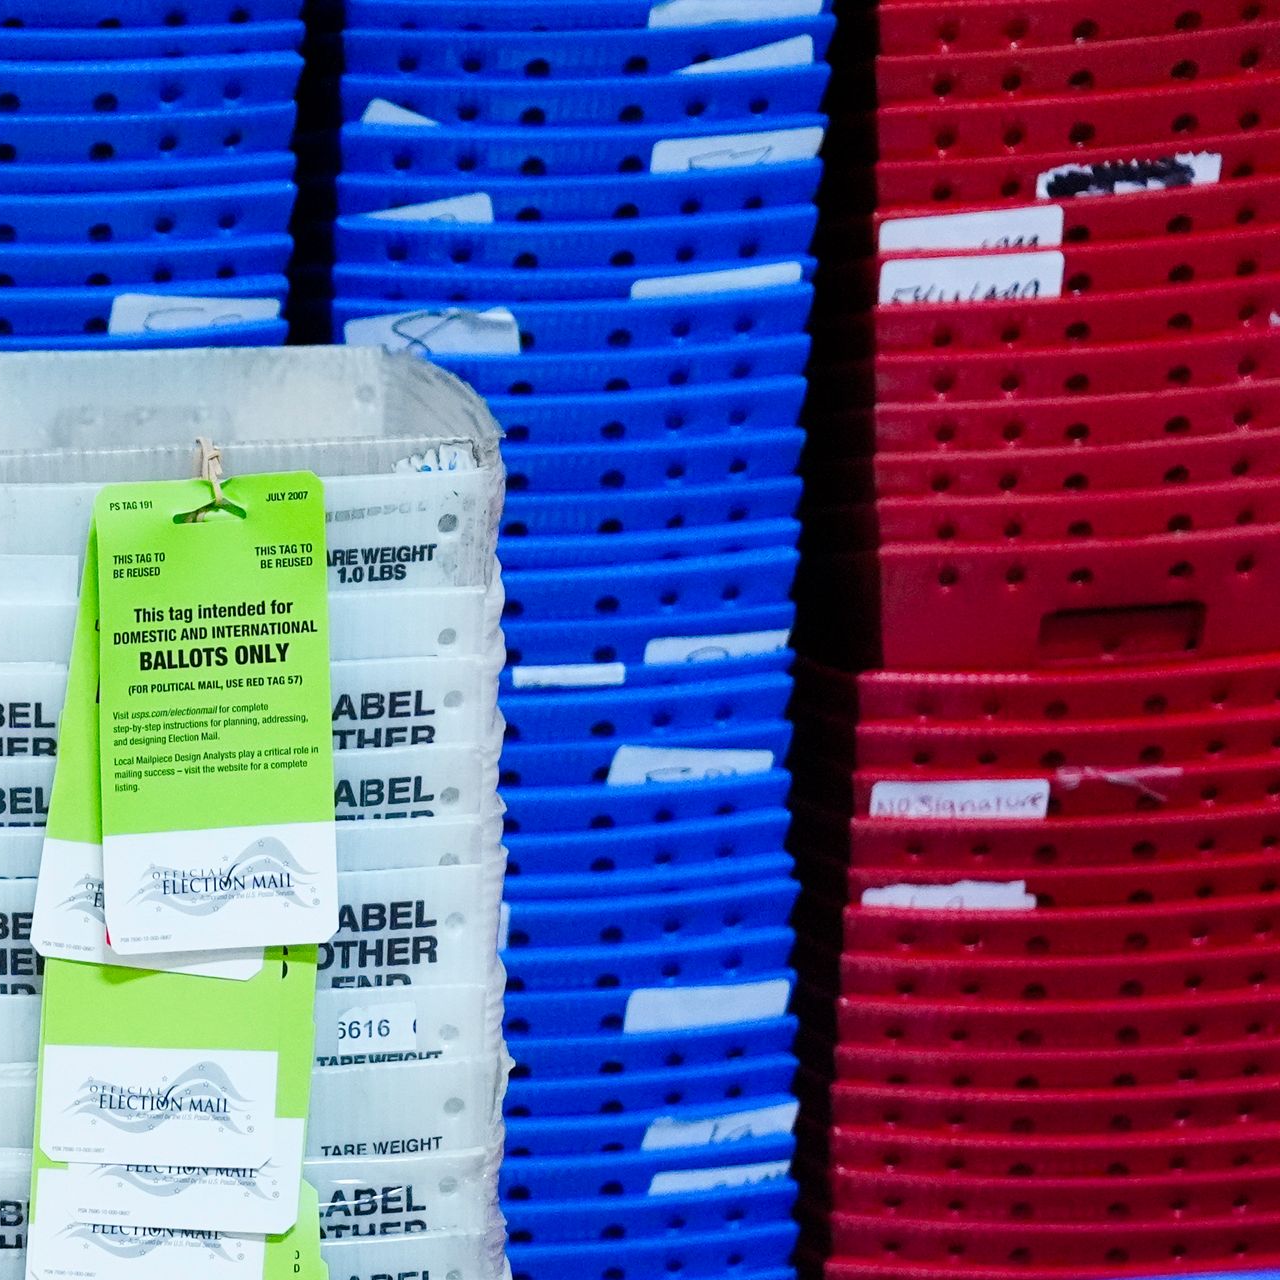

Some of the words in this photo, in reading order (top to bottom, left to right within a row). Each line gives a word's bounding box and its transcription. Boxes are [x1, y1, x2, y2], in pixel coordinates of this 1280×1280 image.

[266, 492, 285, 502] JULY
[288, 491, 308, 500] 2007
[110, 502, 120, 511] PS
[122, 501, 137, 510] TAG
[140, 501, 152, 509] 191
[113, 555, 133, 564] THIS
[136, 553, 151, 563] TAG
[154, 552, 165, 562] TO
[255, 546, 276, 556] THIS
[279, 544, 297, 554] TAG
[300, 543, 312, 553] TO
[261, 559, 272, 569] BE
[276, 557, 313, 567] REUSED
[113, 569, 124, 578] BE
[127, 567, 160, 577] REUSED
[134, 608, 164, 623] This
[169, 607, 192, 623] tag
[198, 601, 265, 619] intended
[271, 600, 293, 614] for
[114, 629, 176, 645] DOMESTIC
[181, 627, 207, 640] AND
[212, 620, 317, 638] INTERNATIONAL
[140, 647, 228, 670] BALLOTS
[235, 643, 289, 665] ONLY
[128, 685, 148, 696] (FOR
[151, 682, 195, 693] POLITICAL
[198, 681, 223, 689] MAIL,
[226, 679, 243, 688] USE
[246, 677, 264, 686] RED
[267, 676, 285, 685] TAG
[288, 675, 302, 685] 57)
[113, 711, 129, 720] Visit
[219, 705, 229, 713] for
[232, 703, 268, 713] complete
[114, 723, 161, 734] step-by-step
[163, 721, 208, 730] instructions
[210, 719, 221, 727] for
[223, 718, 259, 728] planning,
[262, 715, 308, 724] addressing,
[114, 738, 127, 746] and
[130, 736, 166, 746] designing
[168, 734, 199, 743] Election
[201, 732, 219, 740] Mail.
[114, 757, 134, 766] Local
[136, 755, 172, 765] Mailpiece
[175, 754, 201, 763] Design
[203, 751, 236, 761] Analysts
[238, 750, 255, 759] play
[264, 747, 291, 756] critical
[293, 746, 309, 754] role
[115, 770, 142, 779] mailing
[144, 769, 175, 777] success
[184, 766, 200, 774] visit
[203, 765, 215, 773] the
[217, 763, 248, 772] website
[250, 762, 261, 770] for
[271, 760, 307, 769] complete
[115, 784, 139, 792] listing.
[163, 870, 245, 895] ELECTION
[252, 873, 294, 890] MAIL
[321, 1143, 366, 1156] TARE
[373, 1136, 442, 1155] WEIGHT
